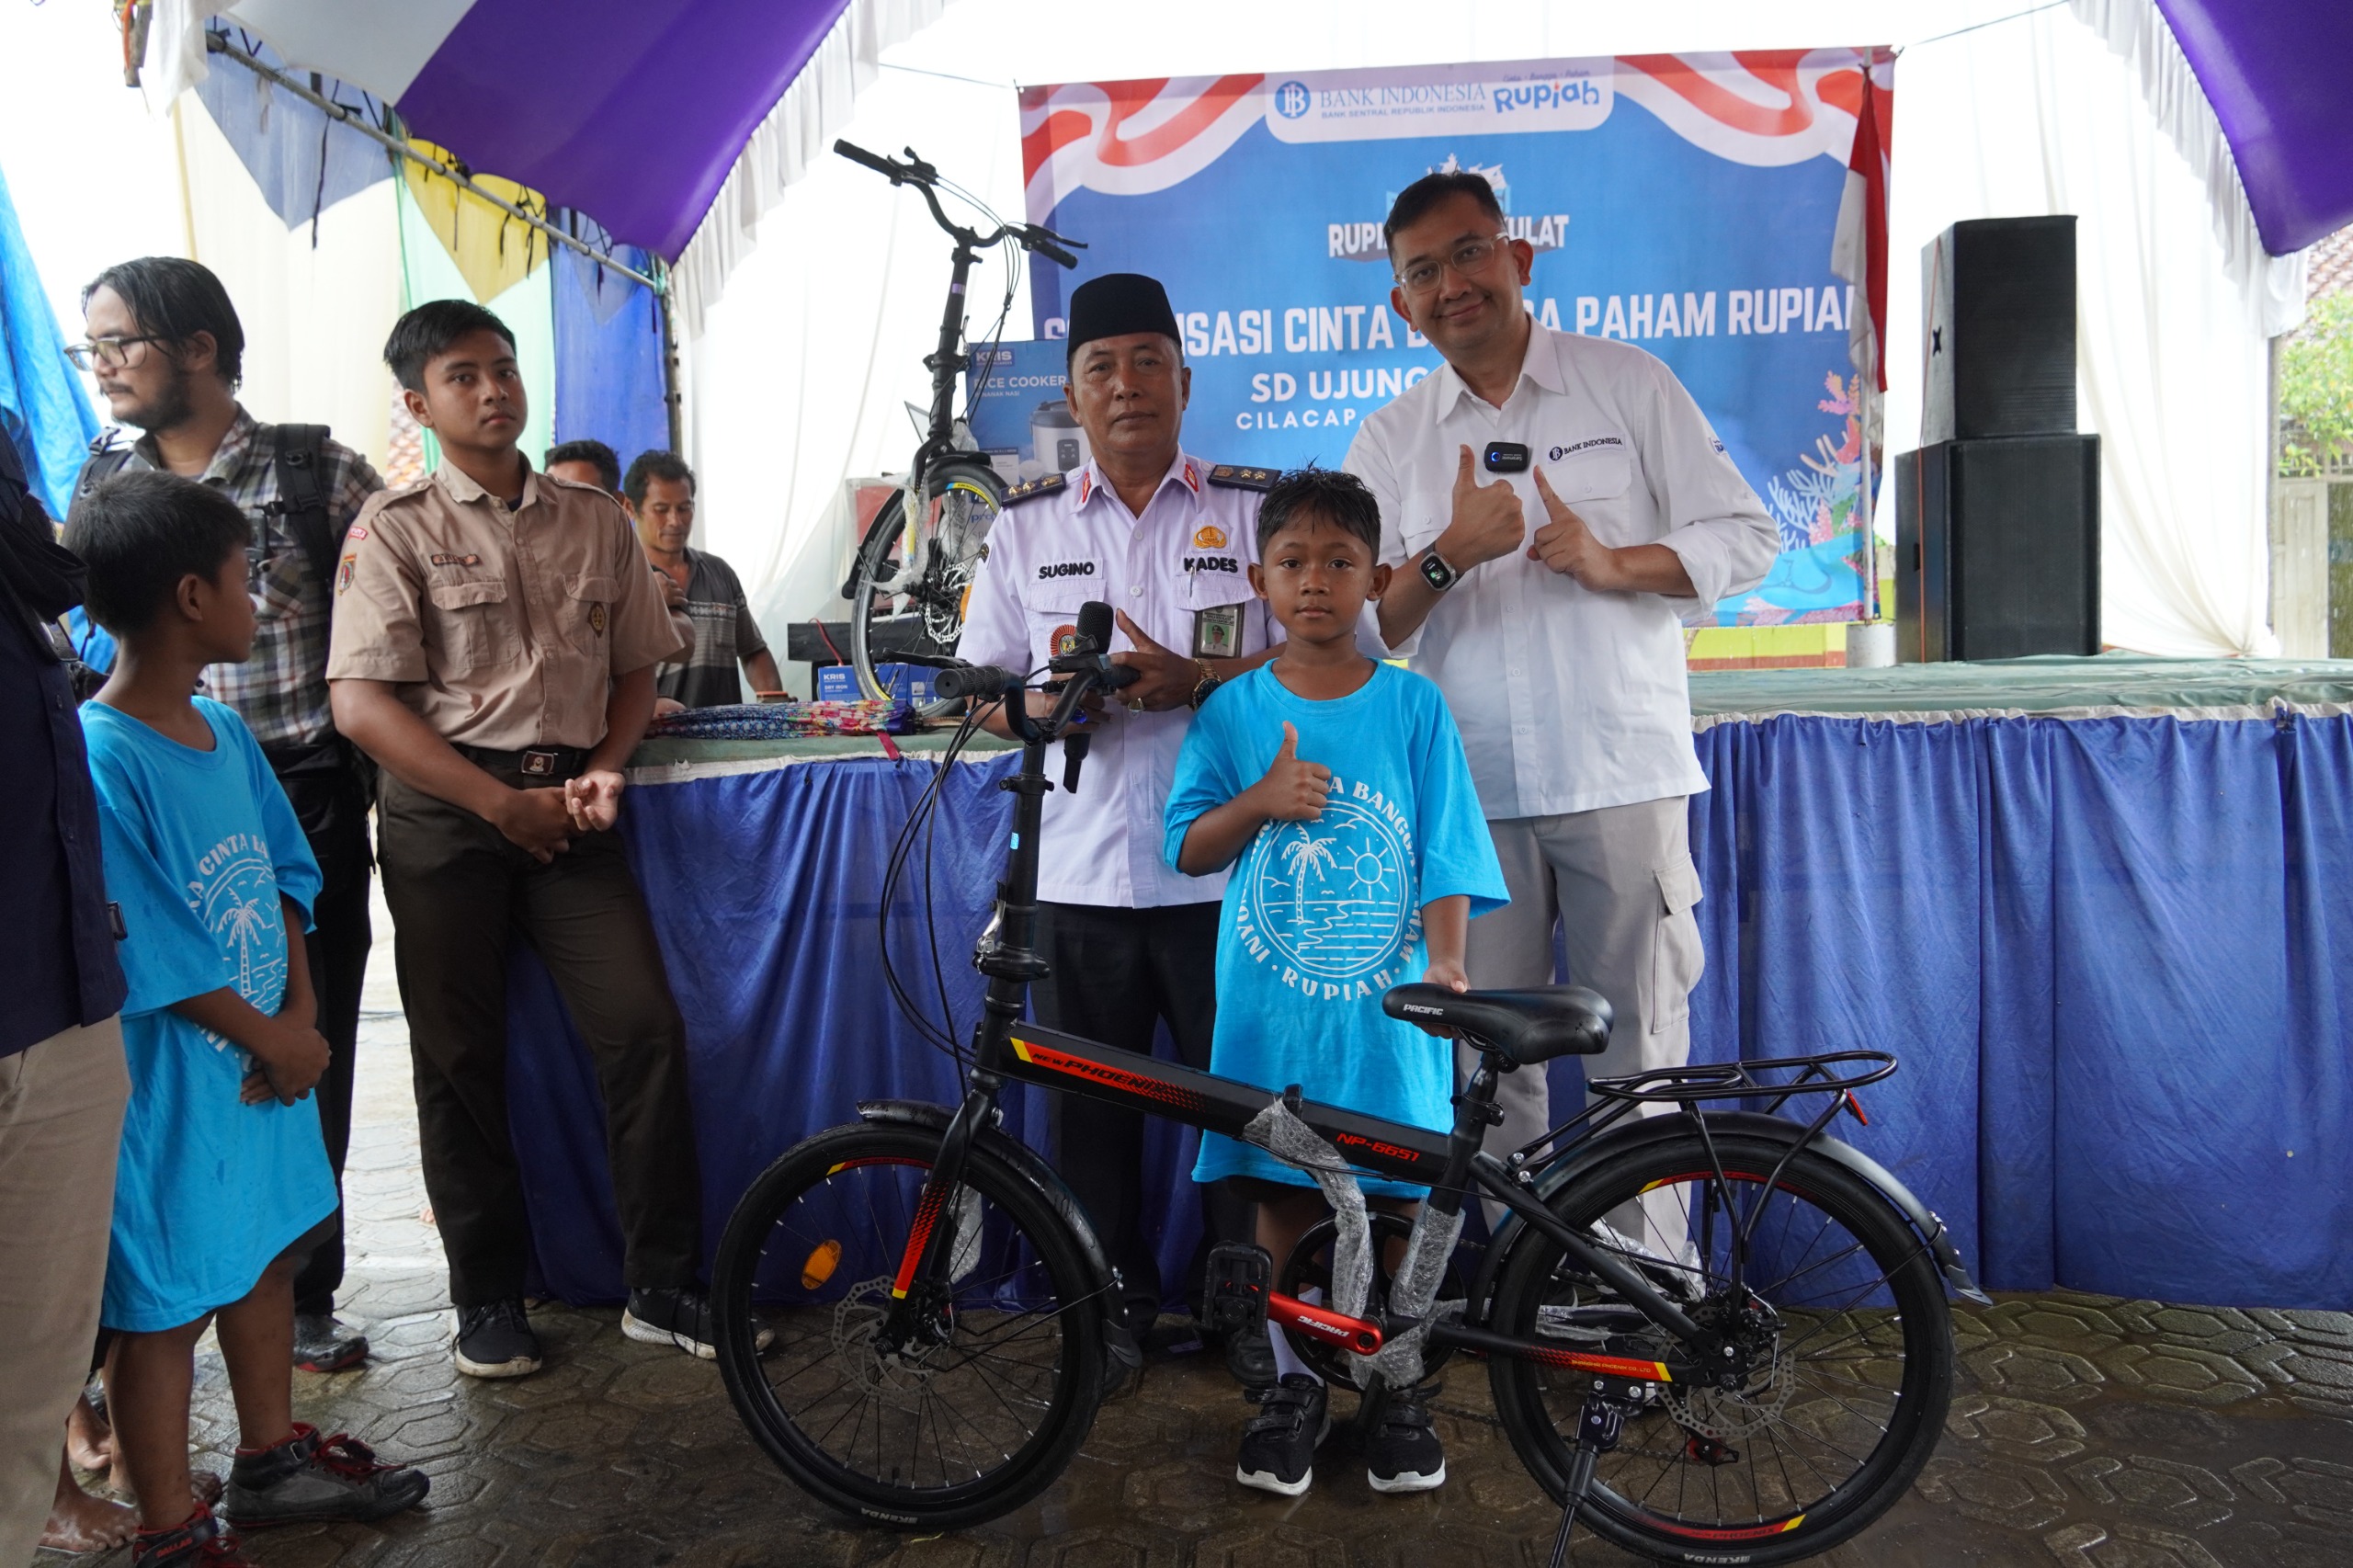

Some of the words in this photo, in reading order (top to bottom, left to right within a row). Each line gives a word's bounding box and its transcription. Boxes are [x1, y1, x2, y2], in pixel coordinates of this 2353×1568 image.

[1321, 87, 1374, 108] BANK
[1381, 82, 1486, 105] INDONESIA
[1493, 80, 1599, 113] Rupiah
[1349, 108, 1387, 118] SENTRAL
[1391, 105, 1434, 115] REPUBLIK
[1437, 103, 1485, 112] INDONESIA
[1328, 222, 1388, 257] RUPI
[1504, 214, 1569, 247] ULAT
[1284, 304, 1395, 354] CINTA
[1576, 291, 1717, 339] PAHAM
[974, 377, 1006, 389] RCE
[1009, 374, 1066, 387] COOKER
[1250, 372, 1297, 403] SD
[1563, 442, 1582, 455] BANK
[1583, 437, 1623, 449] INDONESIA
[1039, 562, 1096, 580] SUGINO
[1184, 556, 1239, 574] KADES
[199, 833, 249, 876] CINTA
[1281, 966, 1392, 1001] RUPIAH
[1403, 1004, 1444, 1016] PACIFIC
[1064, 1060, 1168, 1094] PHOENIX
[1336, 1132, 1420, 1162] NP-6651
[1297, 1315, 1350, 1337] PACIFIC
[860, 1507, 918, 1525] KENDA
[1684, 1552, 1751, 1563] KENDA
